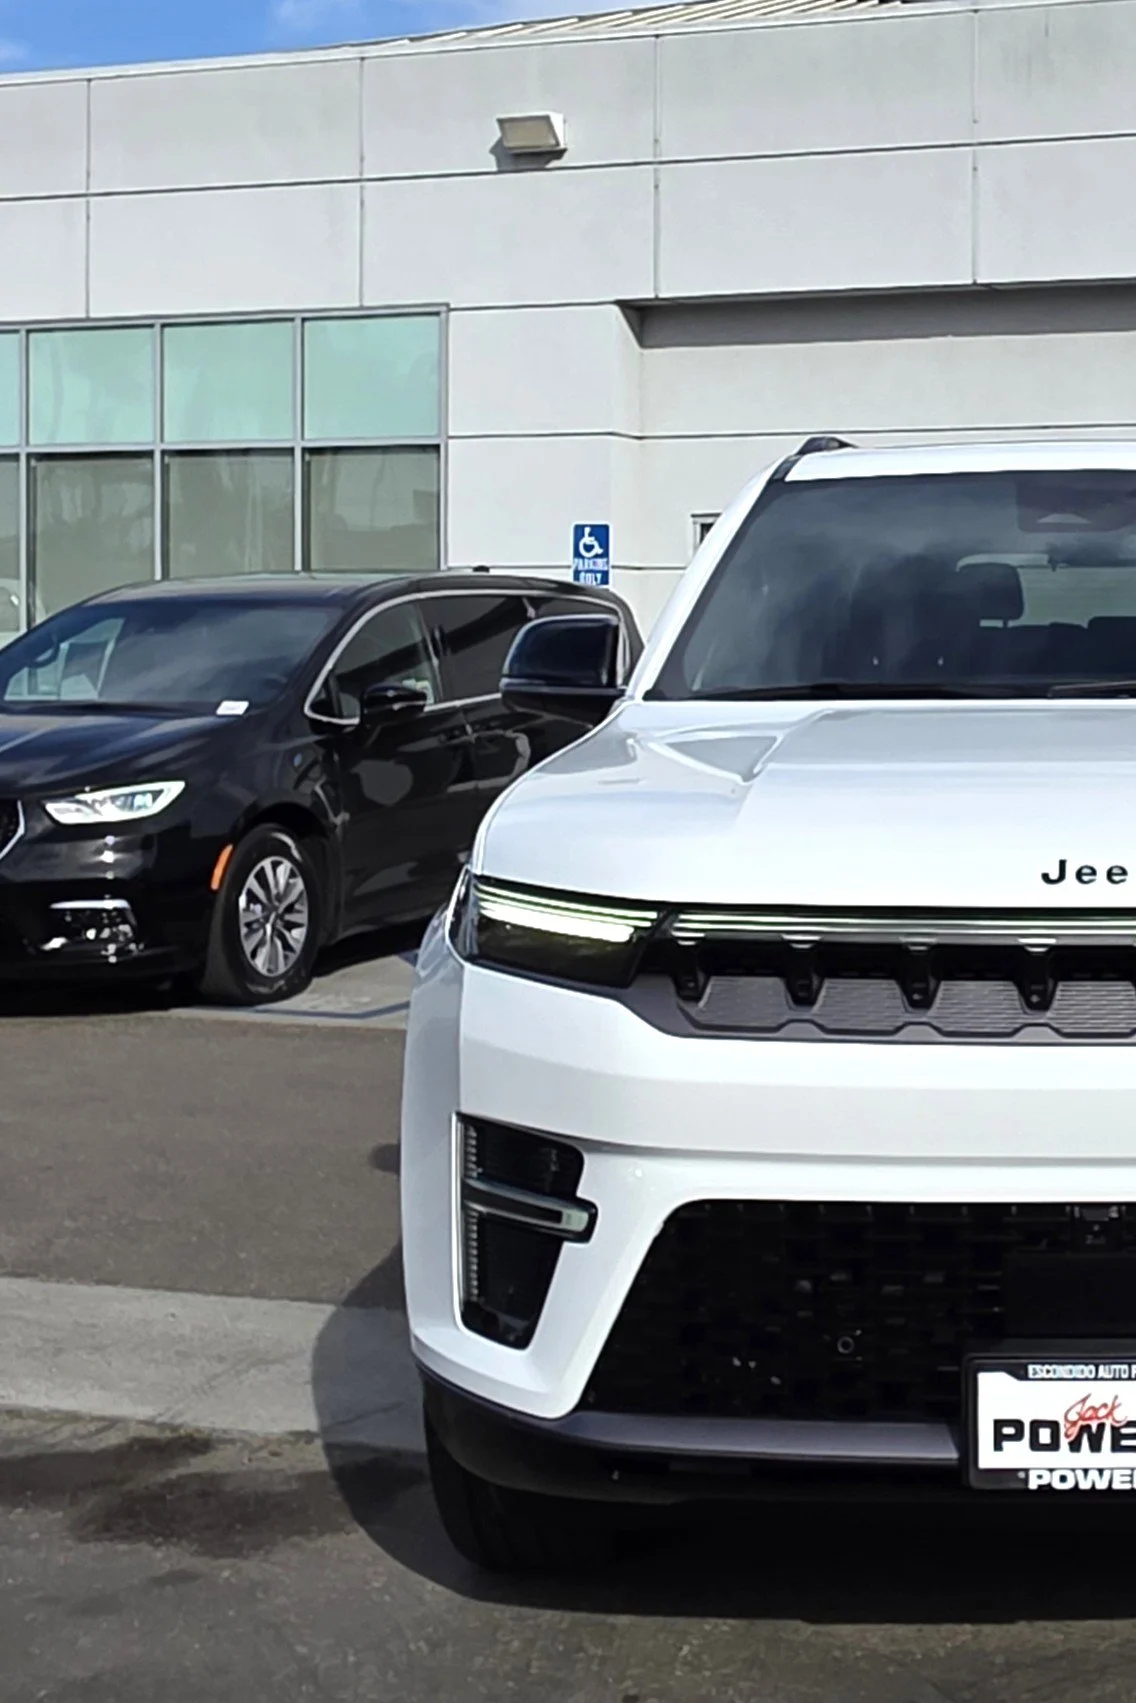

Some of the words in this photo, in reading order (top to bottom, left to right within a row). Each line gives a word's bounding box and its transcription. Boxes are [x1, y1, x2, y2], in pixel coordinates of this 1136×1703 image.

[1028, 1364, 1095, 1379] ESCONDIDO
[1097, 1365, 1129, 1379] AUTO
[1064, 1393, 1128, 1440] Jack
